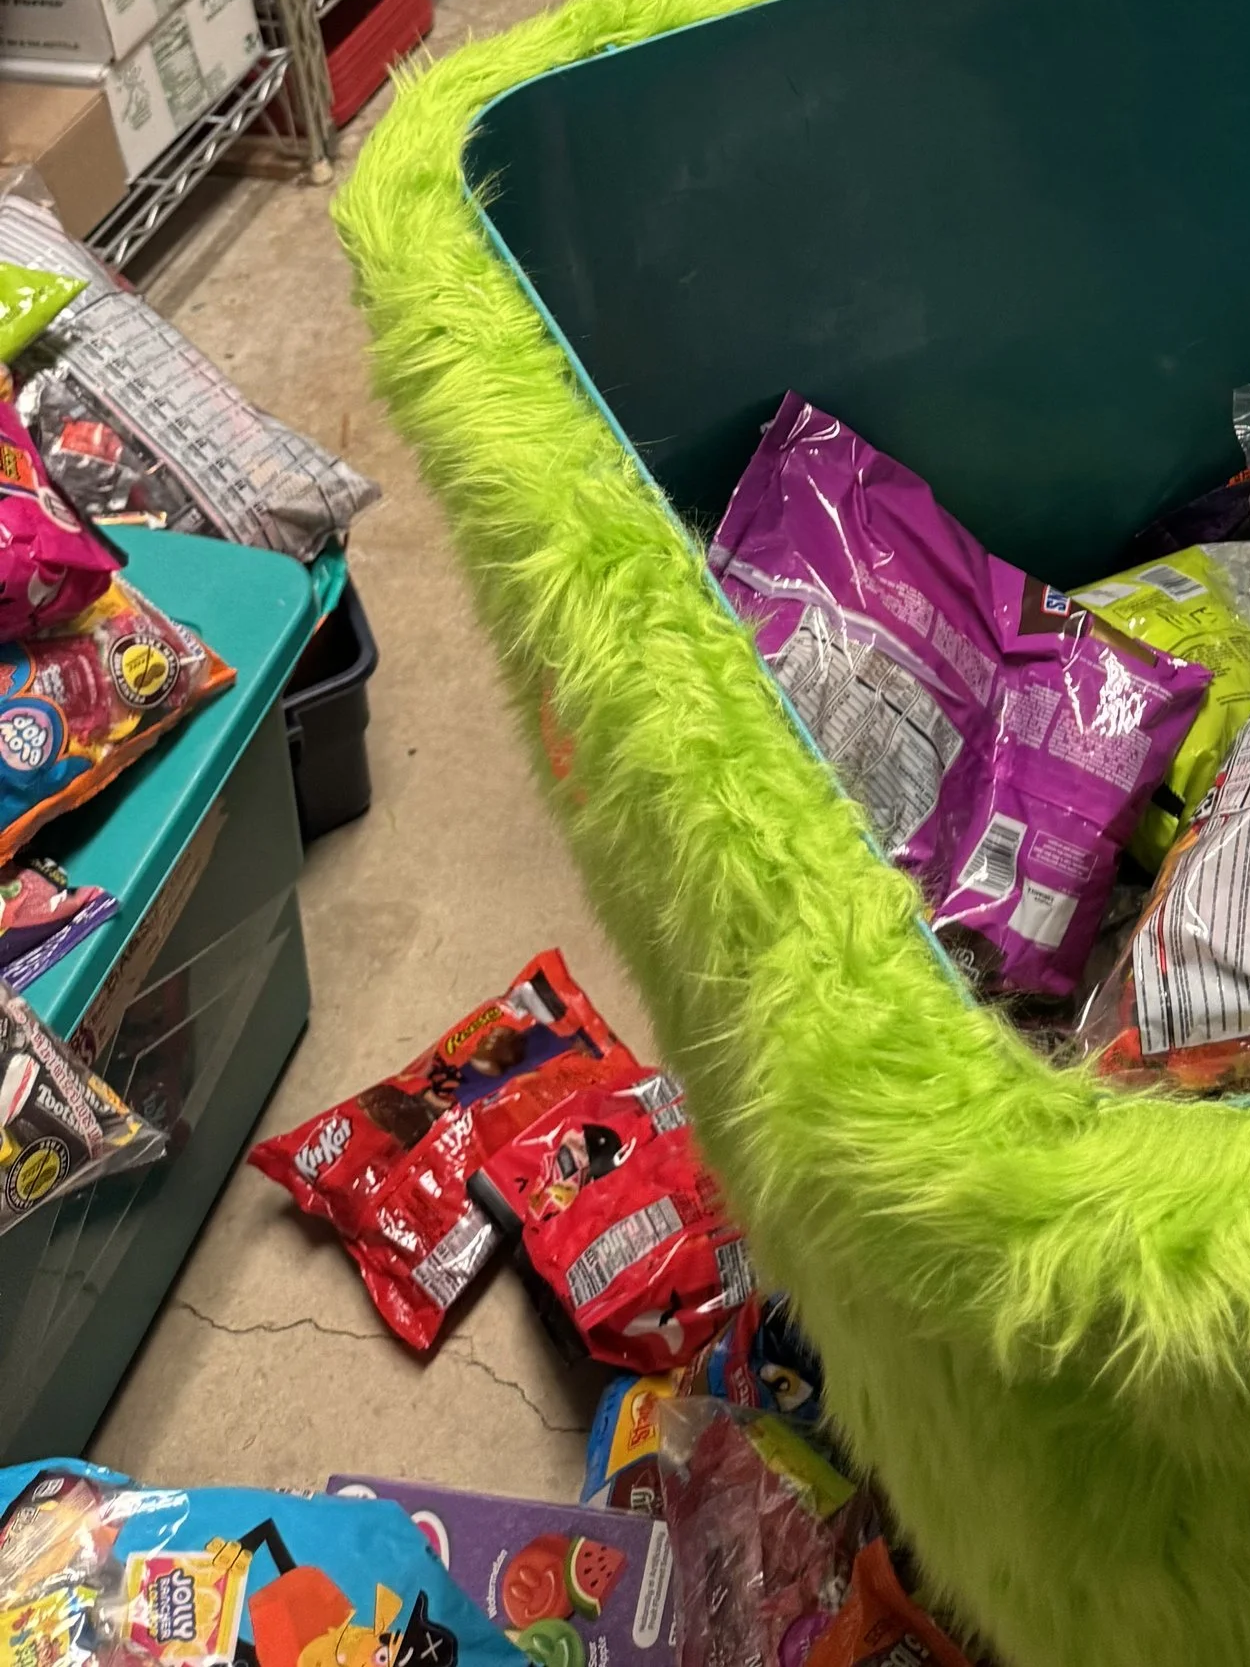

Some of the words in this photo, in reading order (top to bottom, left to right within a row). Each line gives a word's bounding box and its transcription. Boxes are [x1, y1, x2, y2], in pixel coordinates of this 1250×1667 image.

[13, 713, 48, 749] POP
[158, 1577, 173, 1641] RANCHER
[171, 1567, 195, 1642] JOLLY
